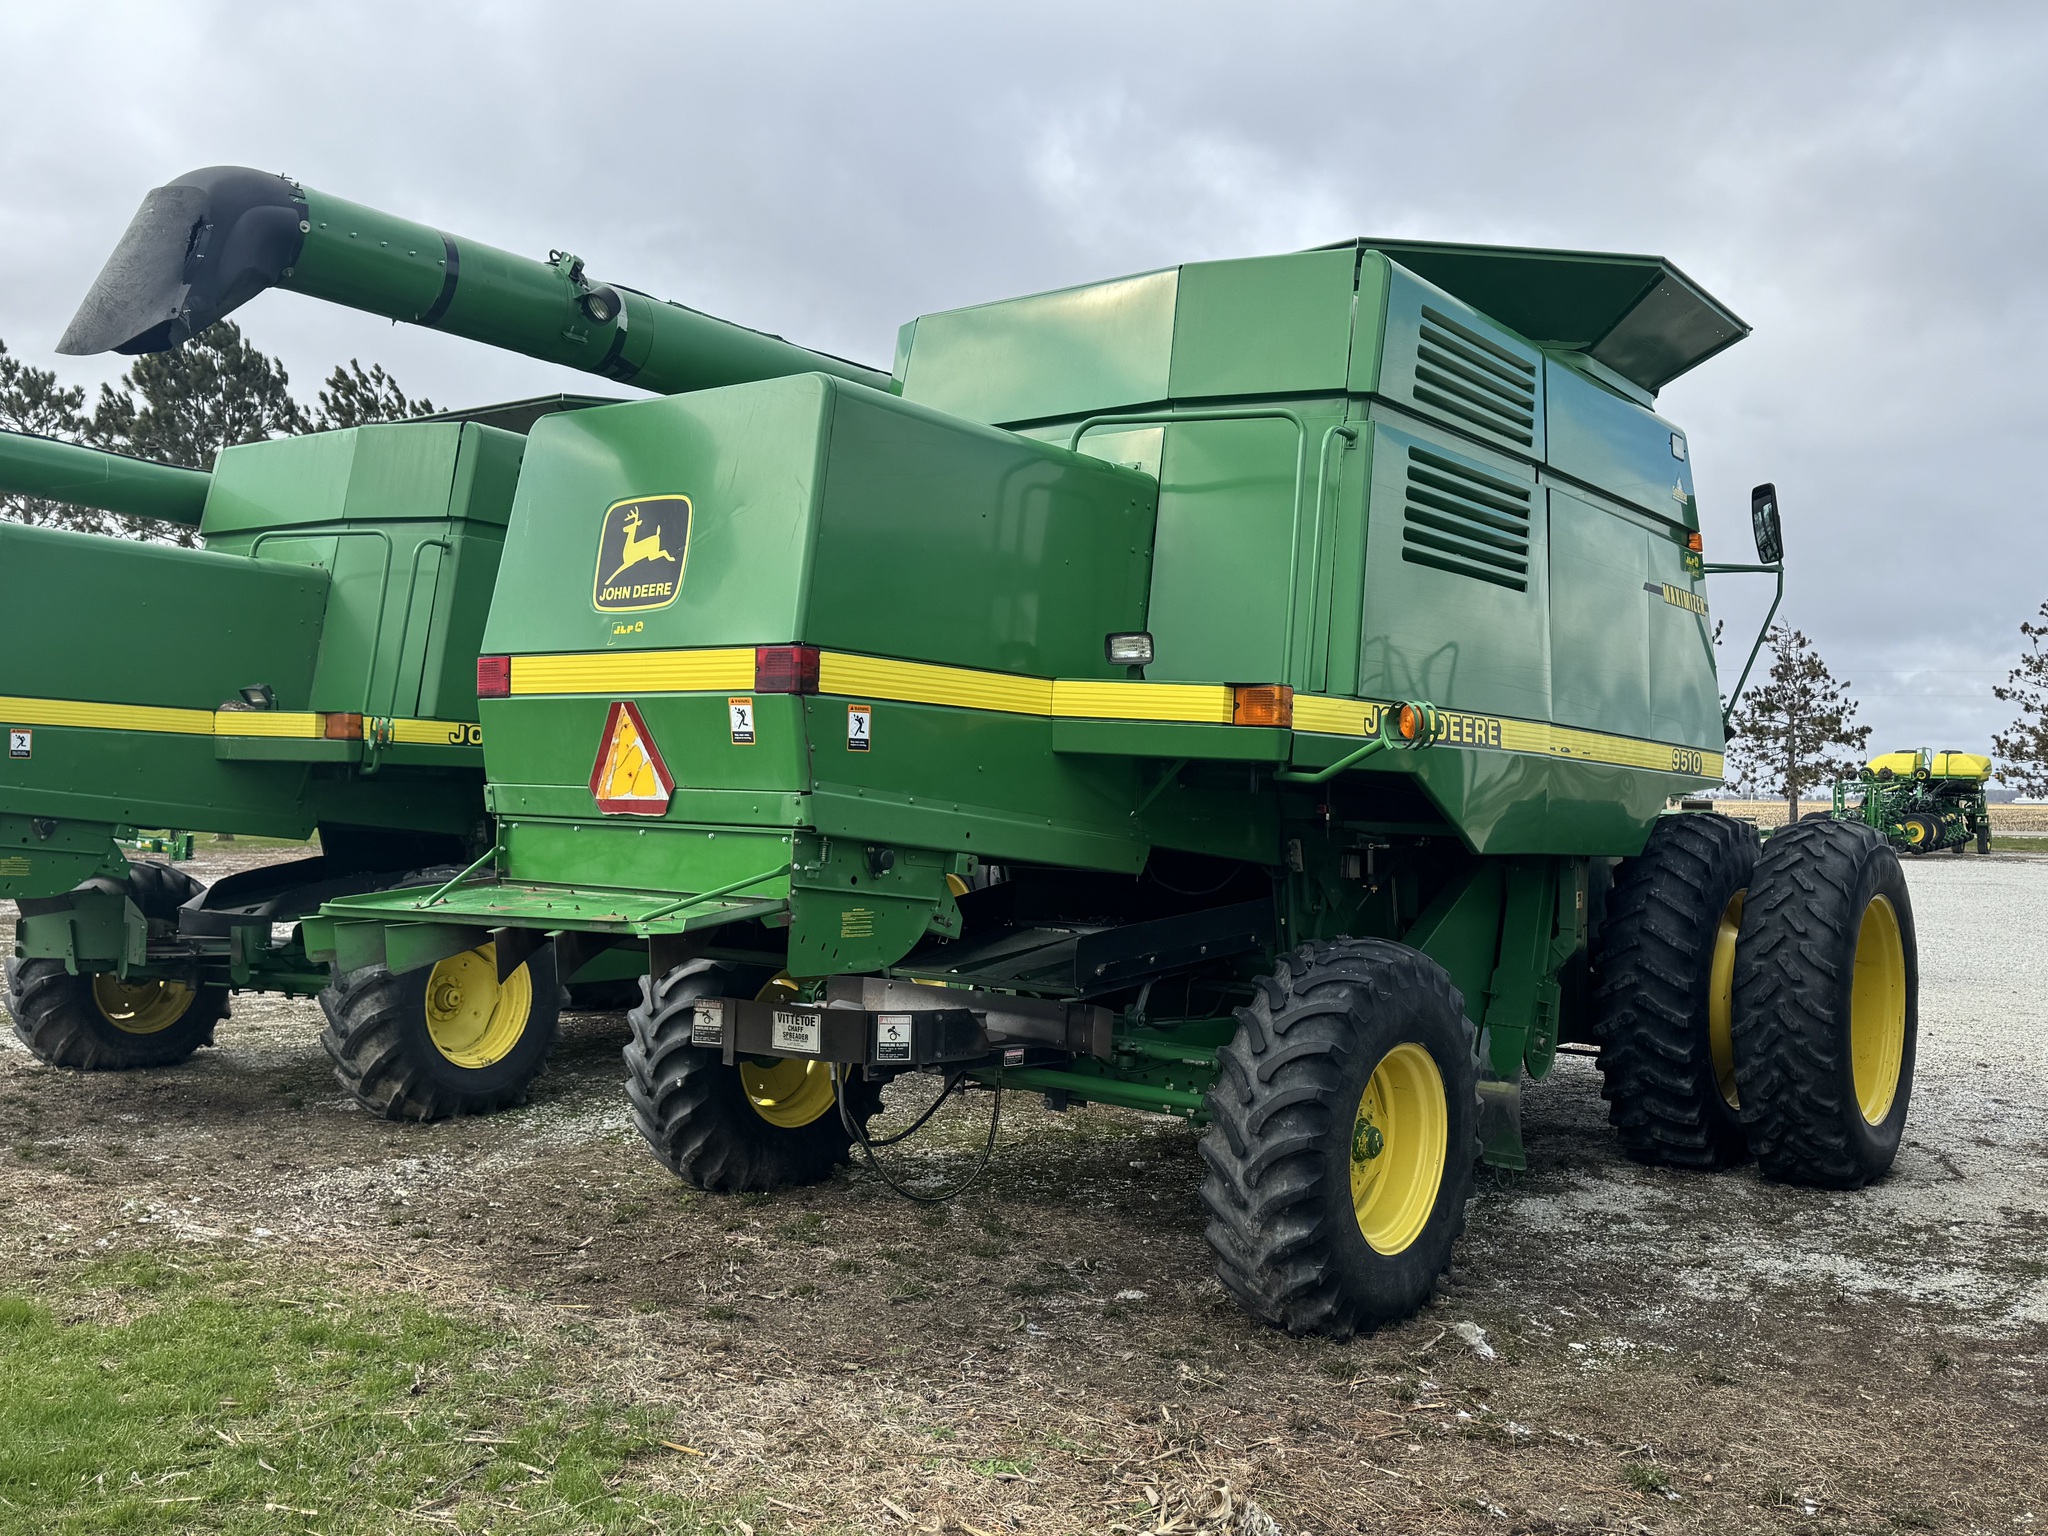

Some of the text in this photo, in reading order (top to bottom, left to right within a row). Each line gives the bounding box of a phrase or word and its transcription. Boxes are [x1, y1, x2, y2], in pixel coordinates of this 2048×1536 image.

[599, 582, 672, 601] JOHN DEERE
[1662, 583, 1705, 615] MAXIMIZER
[449, 724, 483, 745] JO
[1435, 712, 1501, 746] DEERE
[1672, 748, 1702, 773] 9510
[777, 1012, 816, 1027] VITTETOE
[787, 1025, 804, 1033] CHAFF
[782, 1031, 809, 1041] SPREADER
